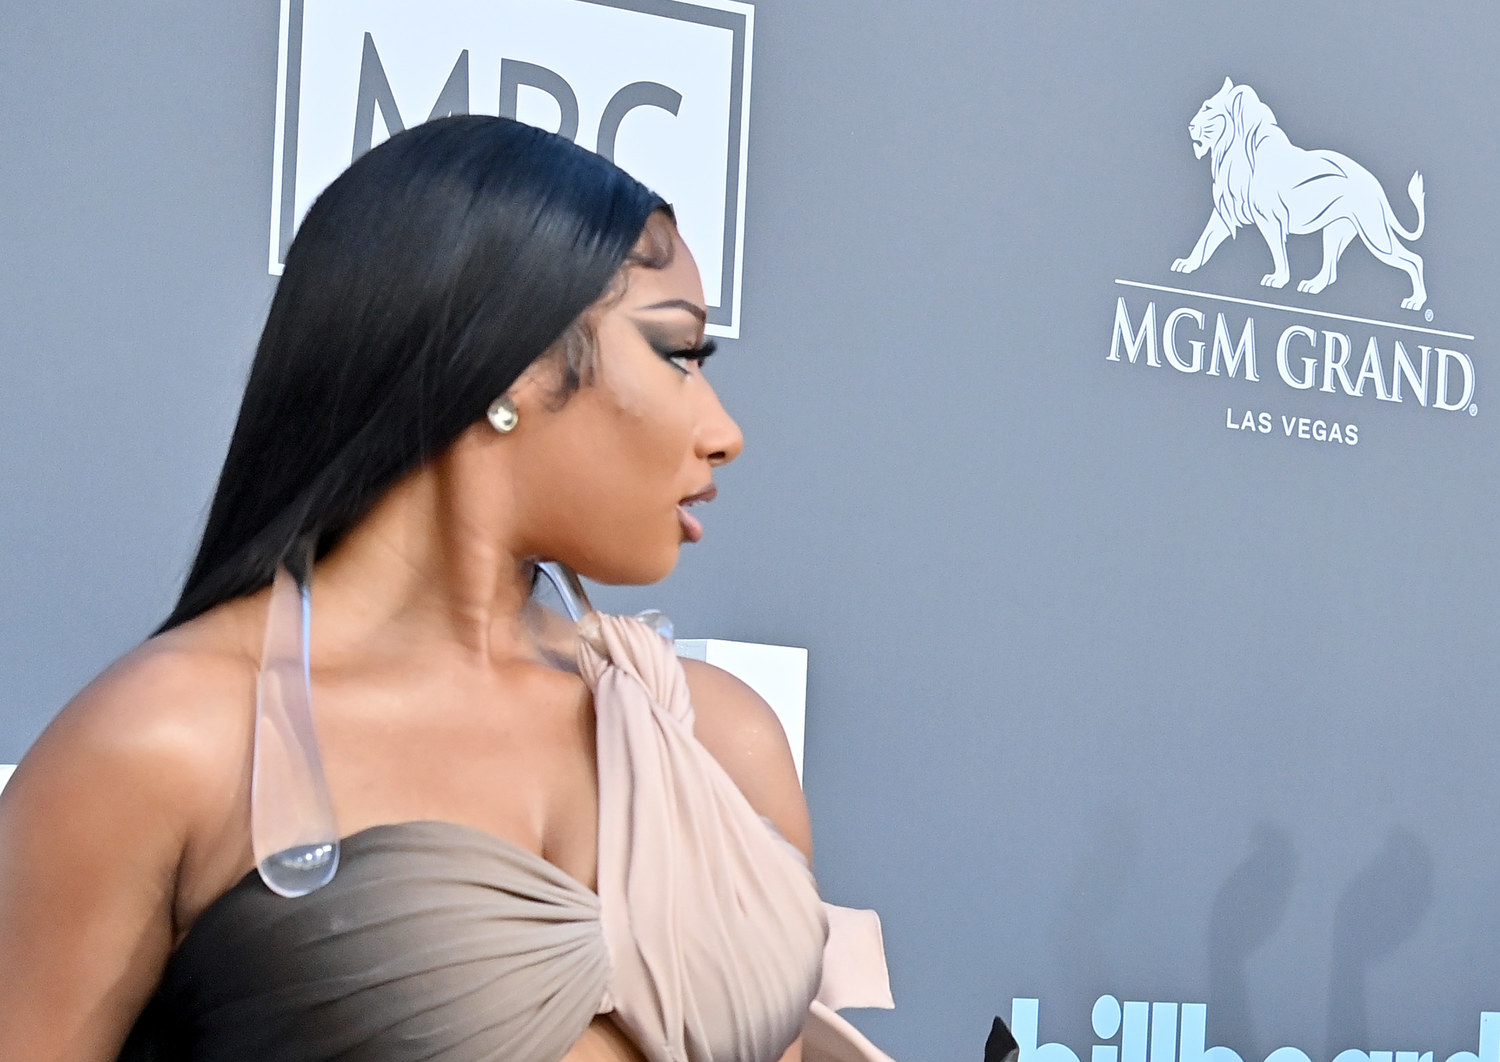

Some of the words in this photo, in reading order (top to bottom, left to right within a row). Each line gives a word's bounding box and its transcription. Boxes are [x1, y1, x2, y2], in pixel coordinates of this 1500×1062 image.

[1106, 296, 1259, 382] MGM
[1276, 325, 1477, 411] GRAND
[1226, 407, 1272, 433] LAS
[1281, 416, 1359, 445] VEGAS
